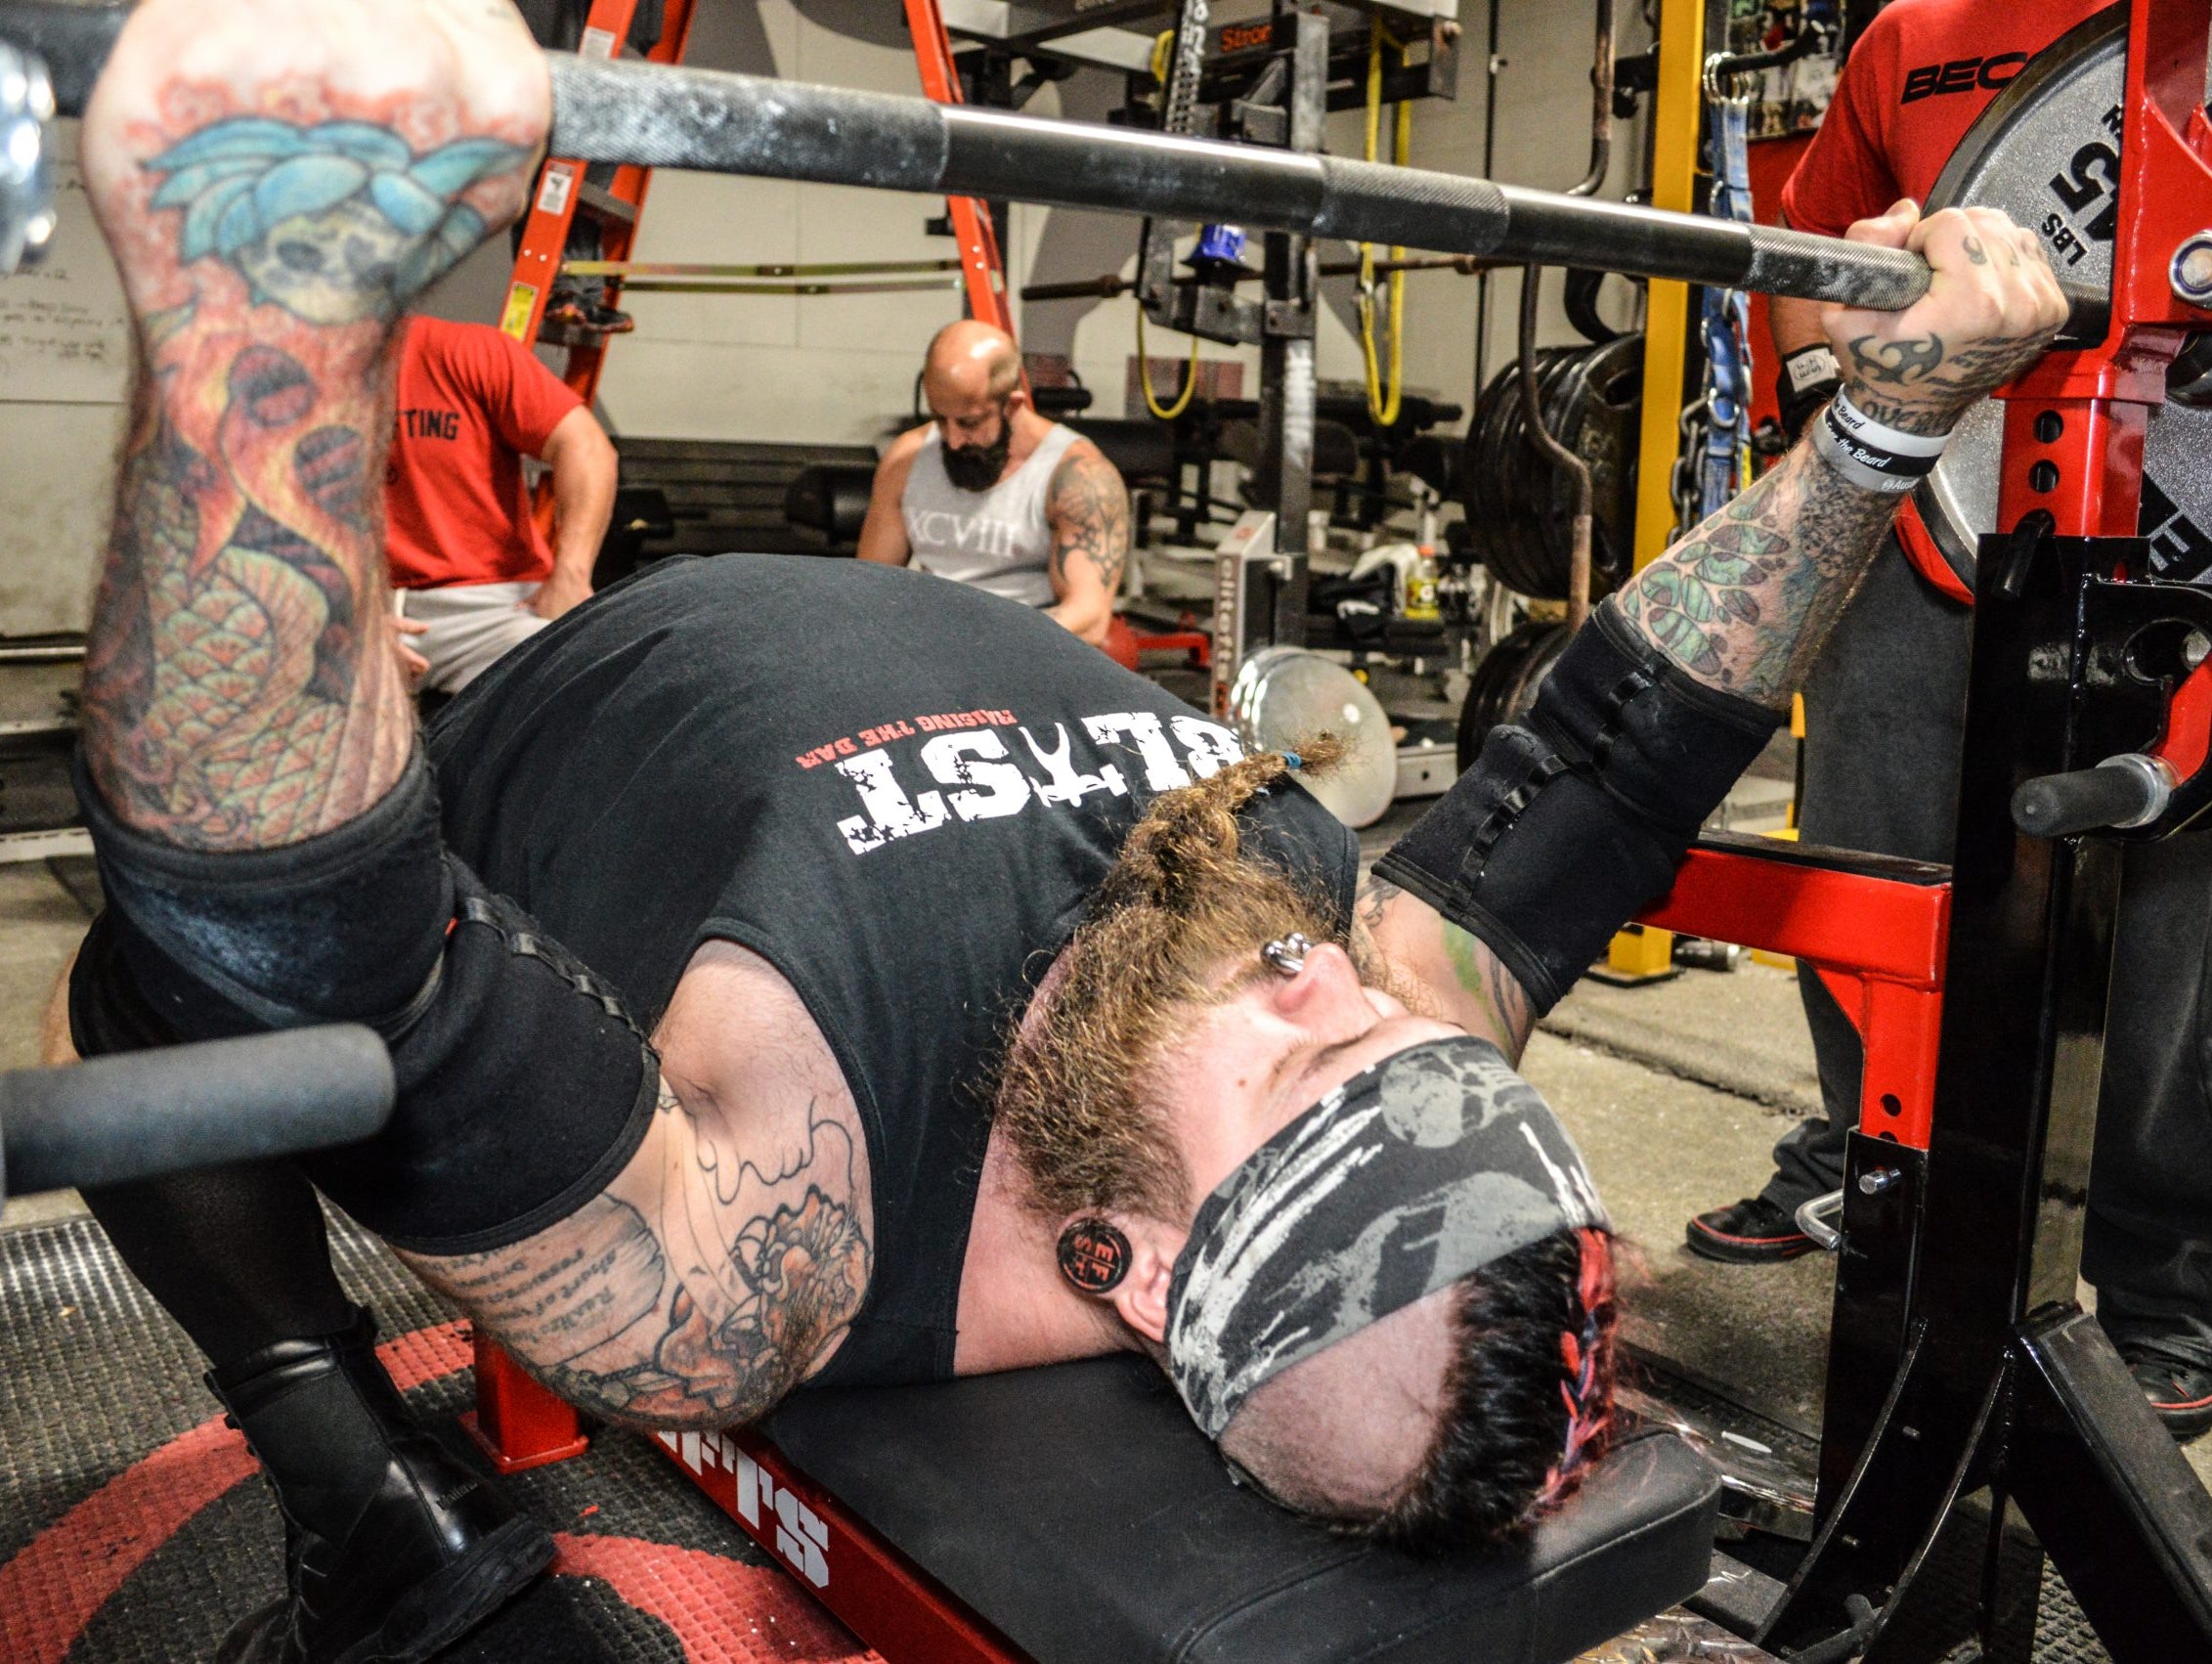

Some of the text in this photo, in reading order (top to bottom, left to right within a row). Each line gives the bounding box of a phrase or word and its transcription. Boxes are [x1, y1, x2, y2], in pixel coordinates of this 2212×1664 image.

[2041, 212, 2089, 267] LBS
[394, 409, 459, 442] TING
[1852, 448, 1893, 469] Beard
[858, 720, 916, 747] THE
[914, 709, 1019, 732] RAISING
